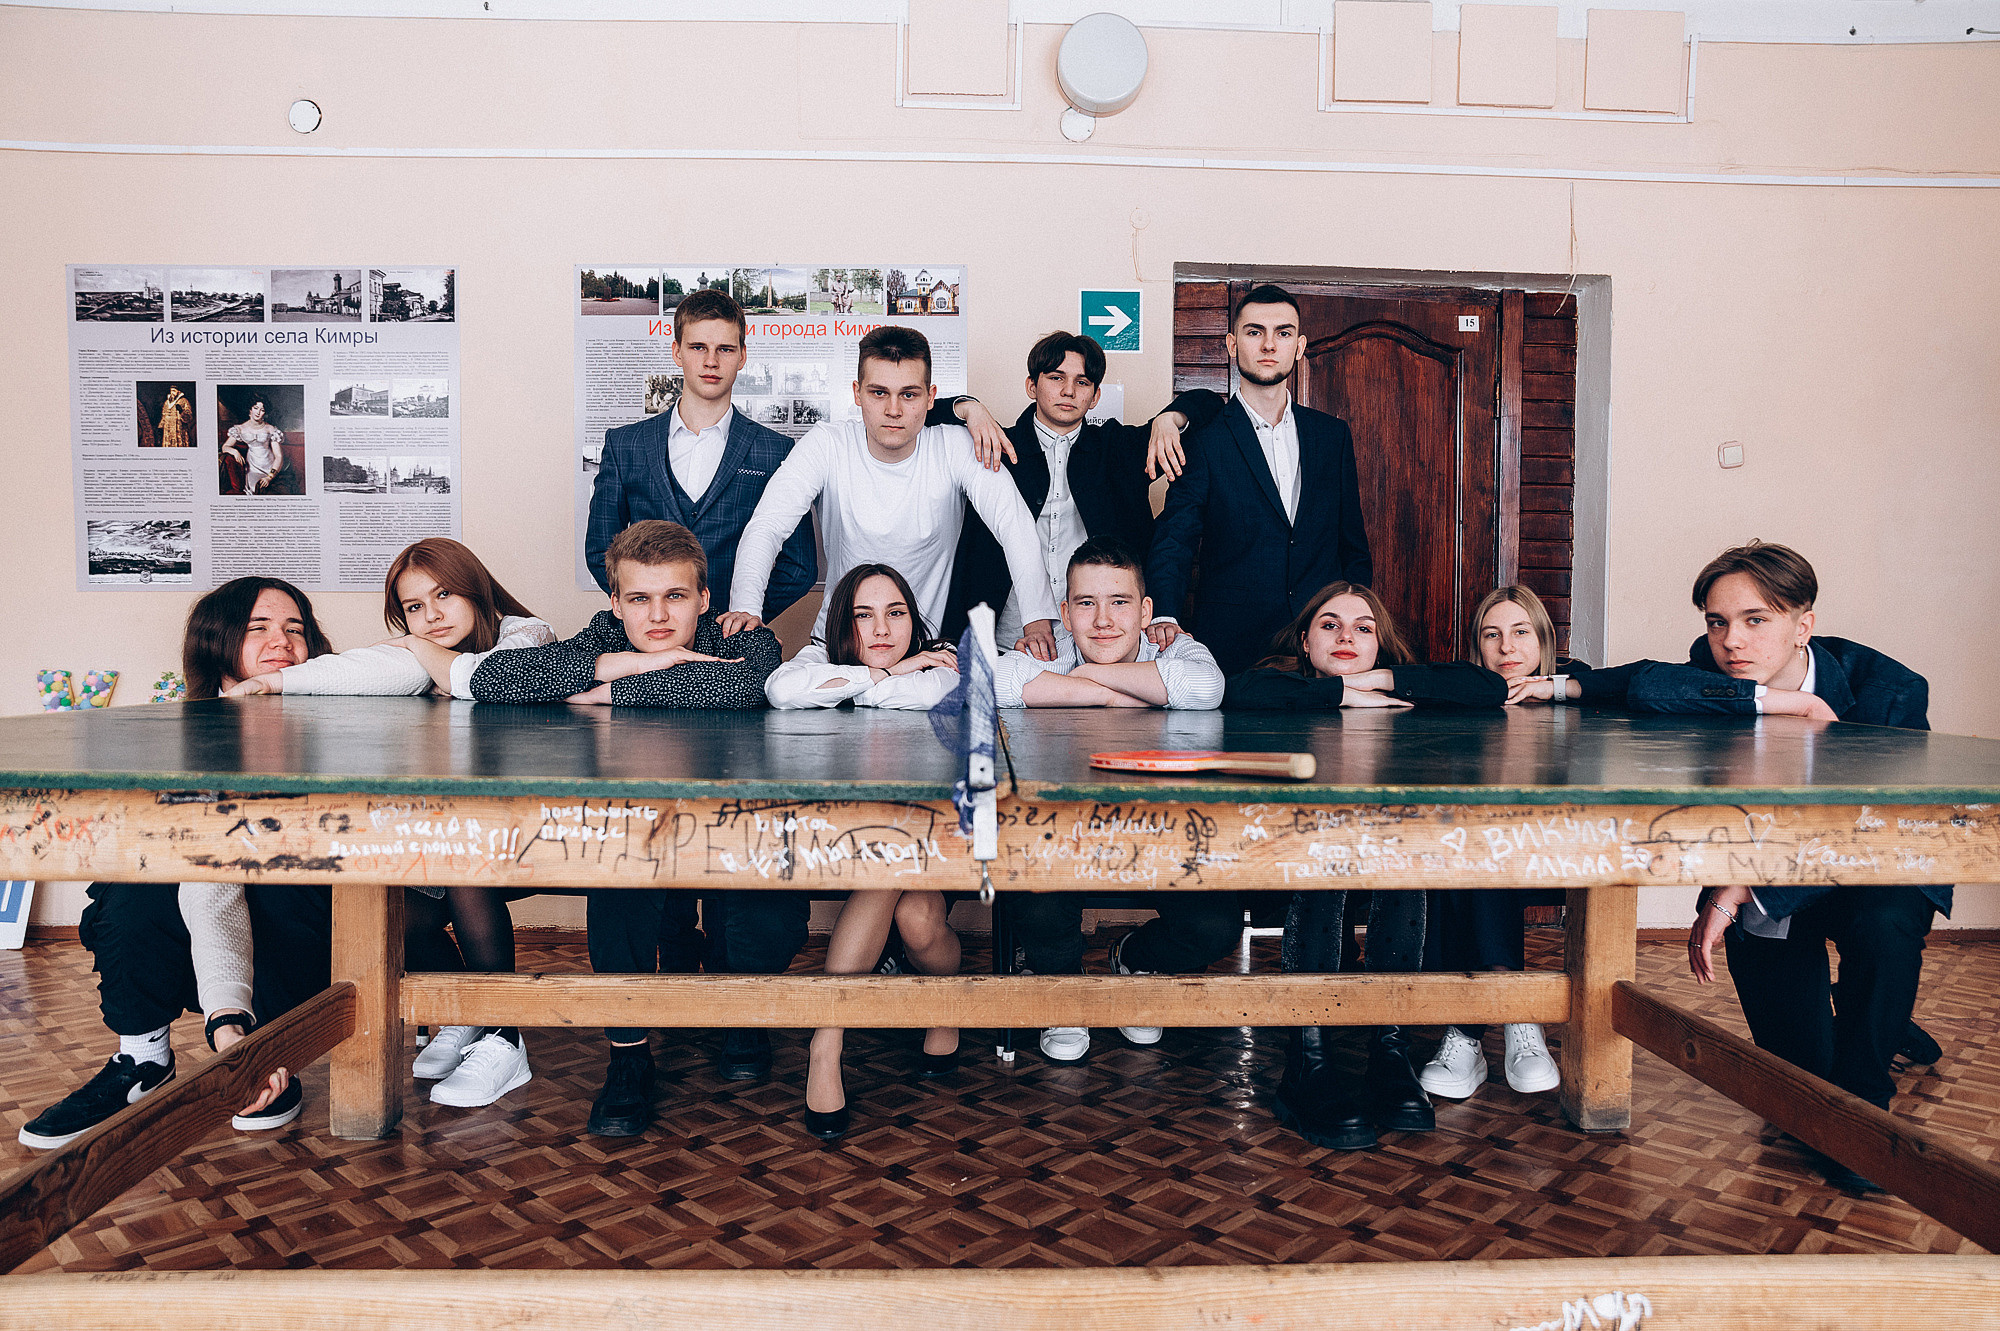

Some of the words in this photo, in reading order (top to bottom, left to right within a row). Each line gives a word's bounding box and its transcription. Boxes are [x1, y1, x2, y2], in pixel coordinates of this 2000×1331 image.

[650, 319, 673, 336] Из
[763, 322, 828, 340] города
[834, 319, 898, 336] Ким
[1465, 318, 1475, 327] 15
[150, 327, 175, 344] Из
[181, 330, 258, 348] истории
[264, 330, 308, 344] села
[315, 327, 378, 347] Кимры
